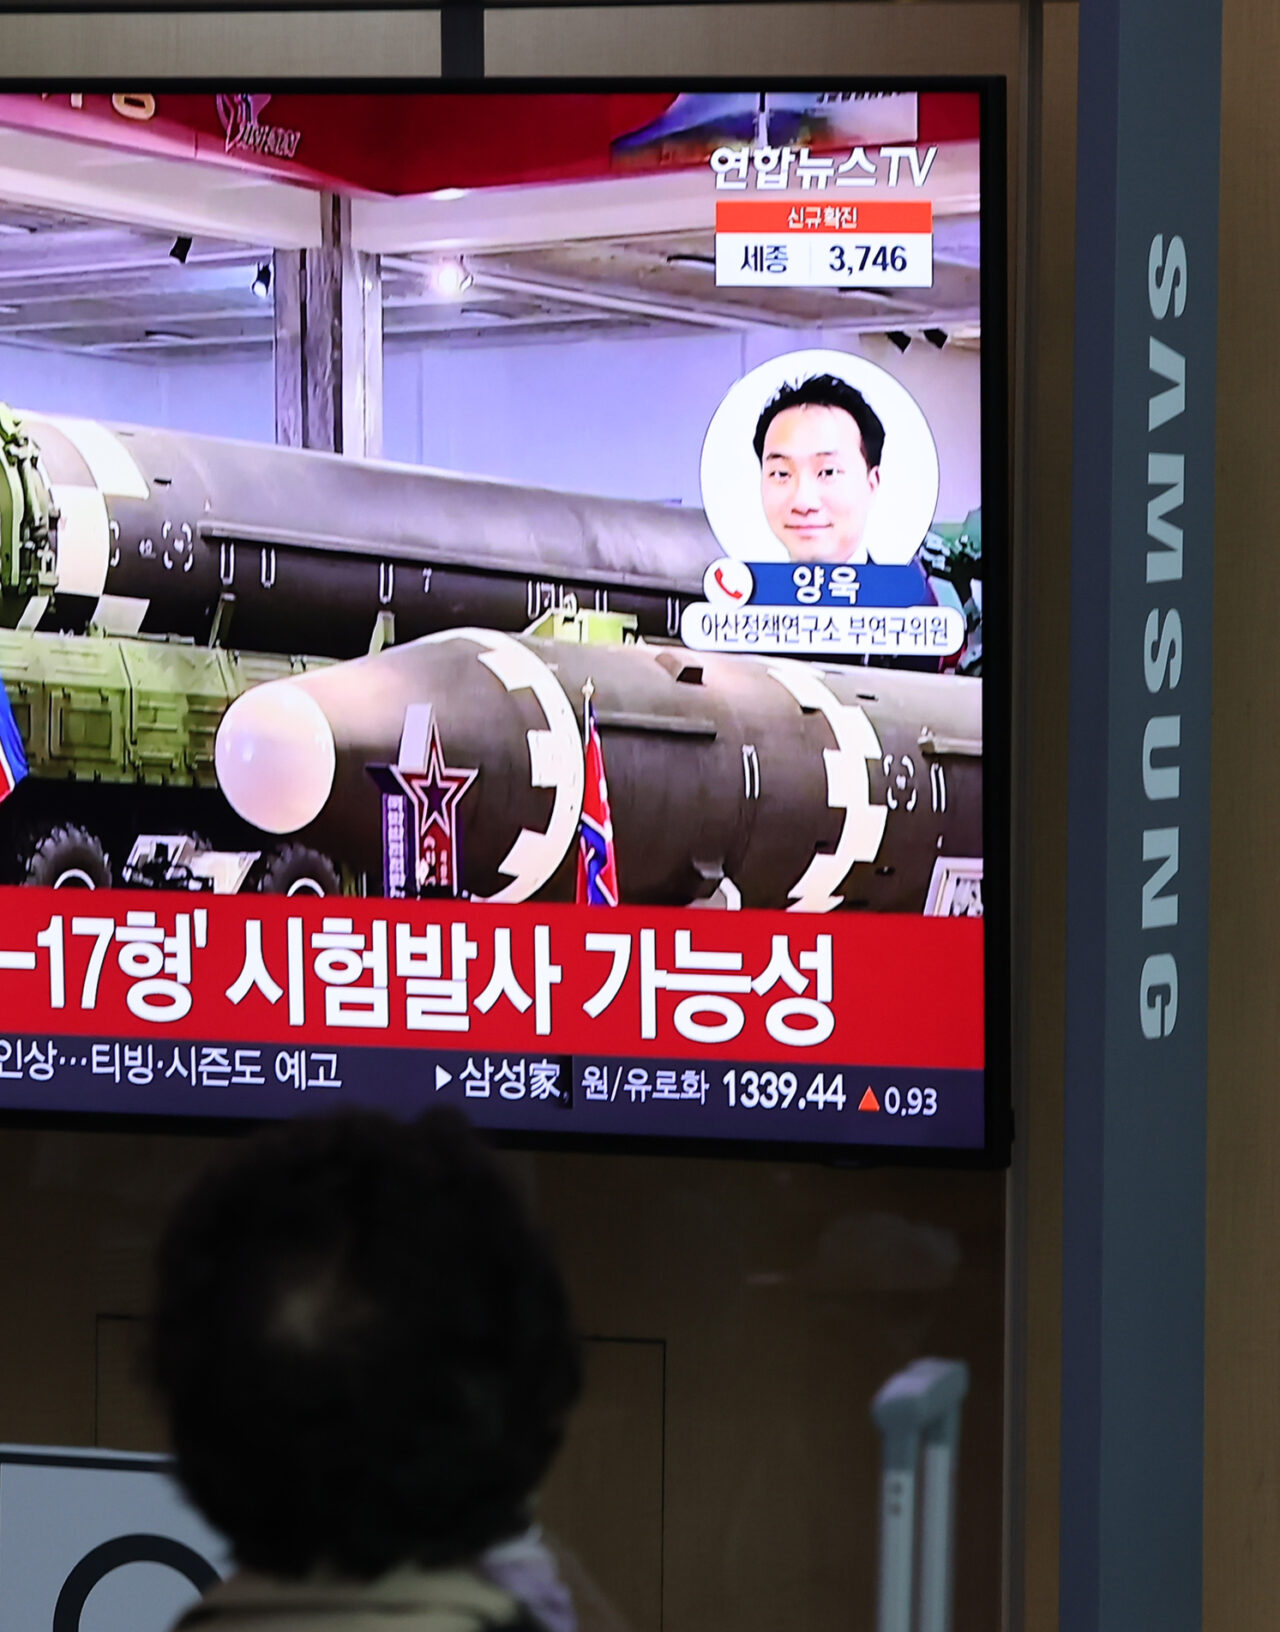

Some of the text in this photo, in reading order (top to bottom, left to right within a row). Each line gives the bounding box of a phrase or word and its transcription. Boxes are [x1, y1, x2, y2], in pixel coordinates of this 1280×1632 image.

[709, 146, 938, 190] 연합뉴스TV
[787, 205, 858, 230] 신규확진
[740, 244, 908, 276] 세종 3,746
[701, 612, 949, 647] 아산정책연구소 부연구위원
[1139, 232, 1188, 1040] SAMSUNG
[225, 916, 563, 1037] 시험발사
[582, 928, 836, 1047] 가능성
[274, 1050, 343, 1091] 예고
[580, 1065, 938, 1117] 원/유로화 1339.44 0.93
